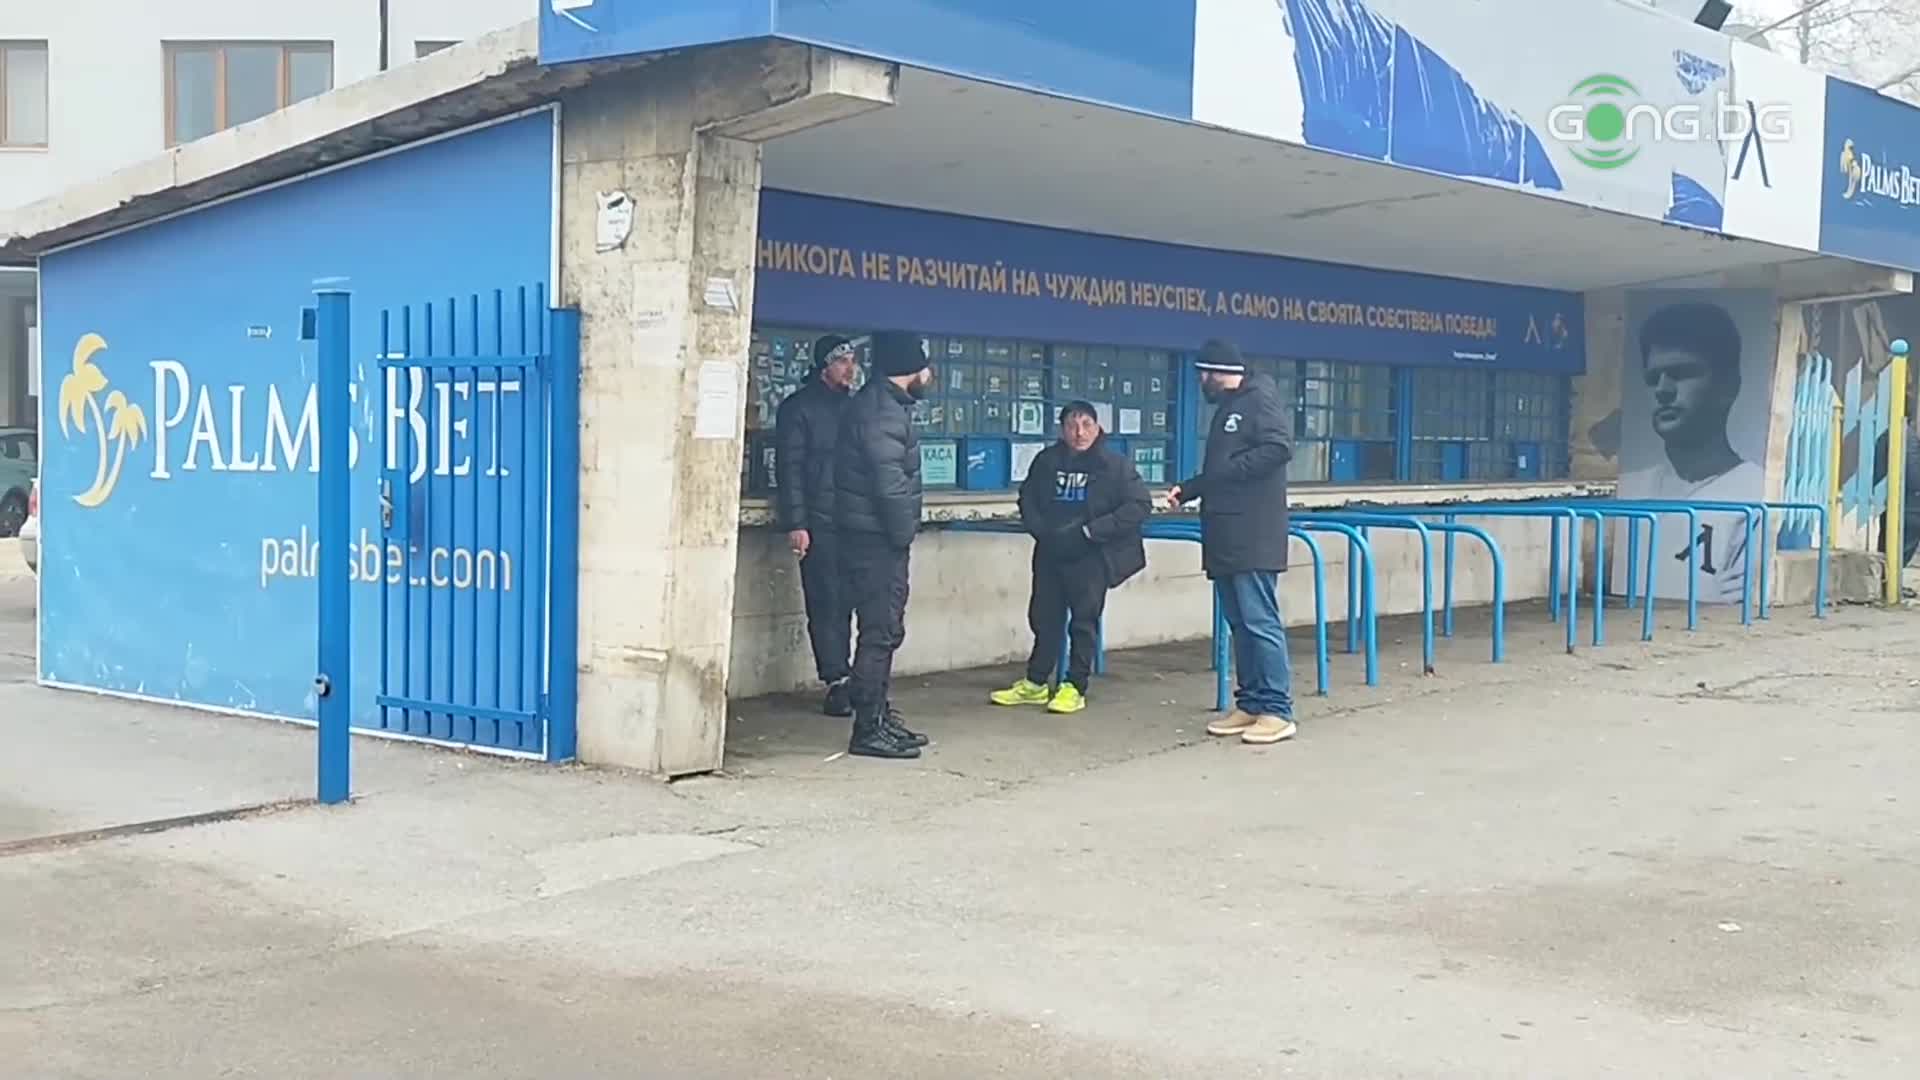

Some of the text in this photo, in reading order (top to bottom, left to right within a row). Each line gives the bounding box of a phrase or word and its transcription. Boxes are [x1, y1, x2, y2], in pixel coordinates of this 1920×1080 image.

[757, 238, 1496, 341] НИКОГА НЕ РАЗЧИТАЙ НА ЧУЖДИЯ НЕУСПЕХ, А САМО НА СВОЯТА СОБСТВЕНА ПОБЕДА!
[386, 352, 521, 484] BET
[261, 524, 511, 591] palsbe.com
